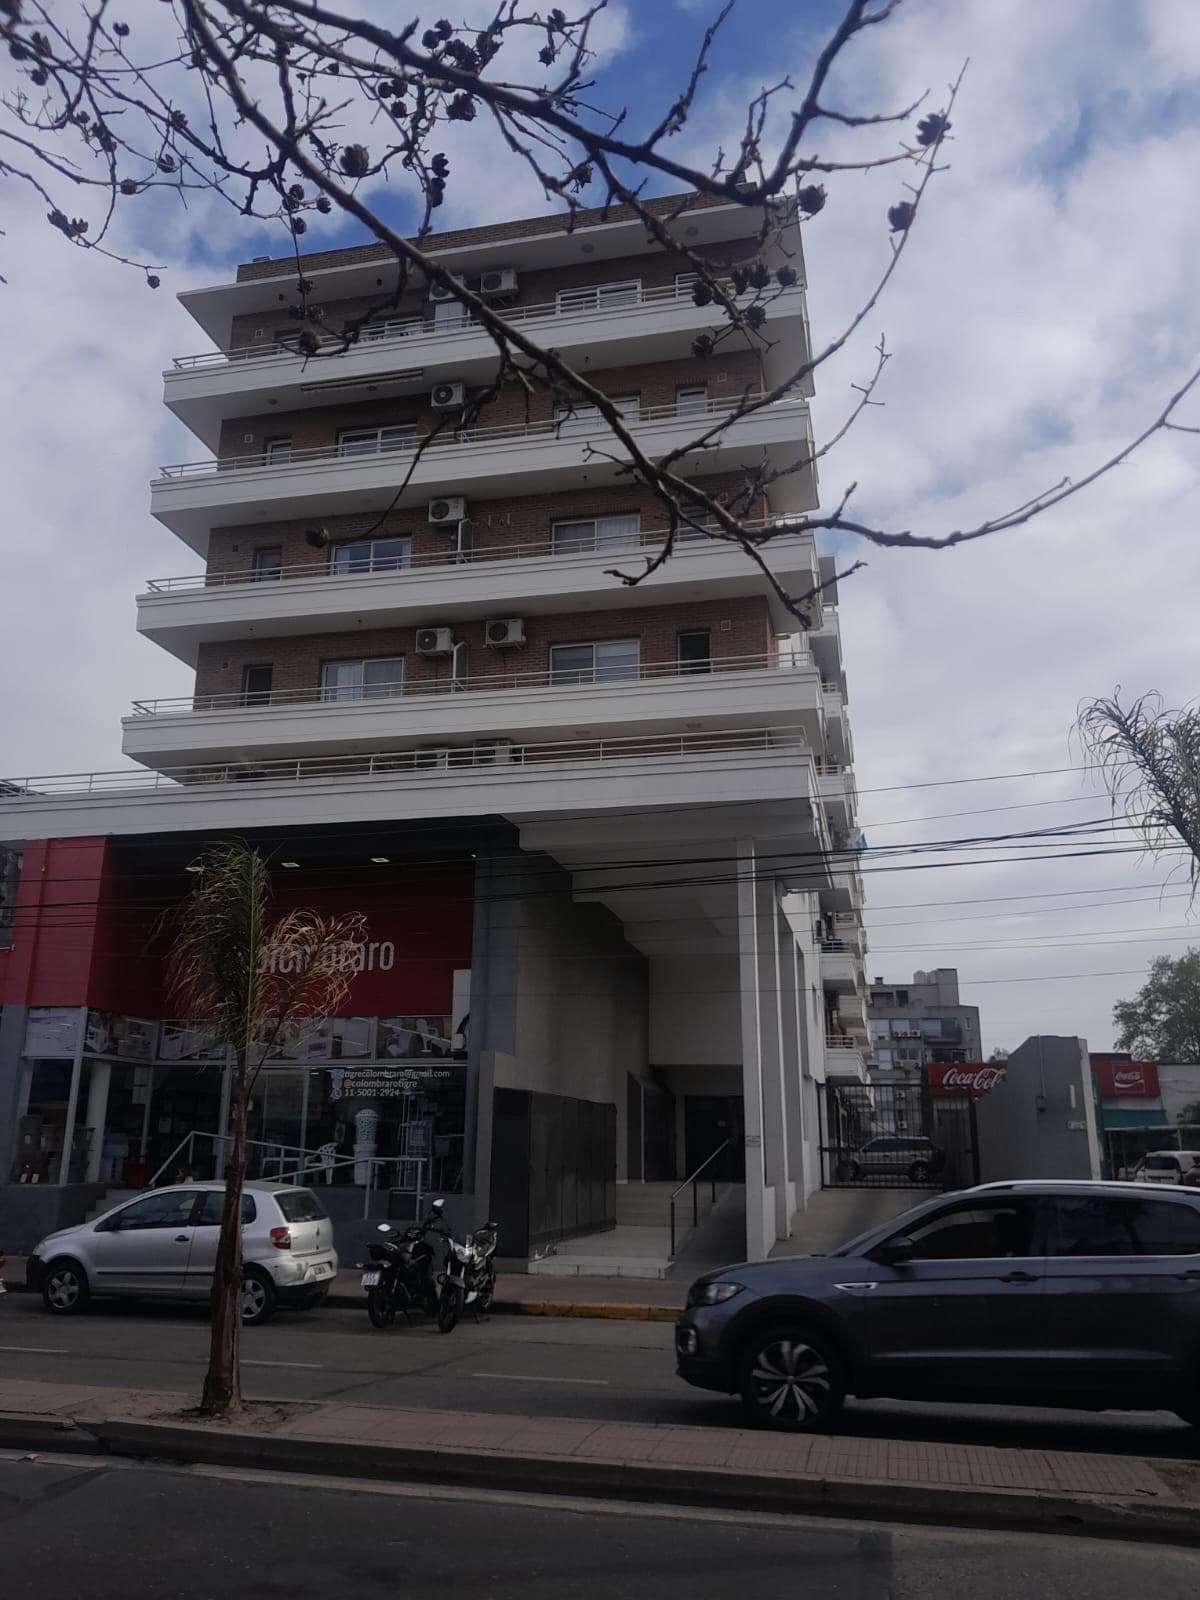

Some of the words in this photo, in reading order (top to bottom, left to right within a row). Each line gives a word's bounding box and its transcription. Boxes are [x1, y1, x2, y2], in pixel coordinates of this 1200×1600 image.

[942, 1068, 1007, 1089] Coca-Col
[343, 1079, 418, 1089] @colombrarotigre
[344, 1088, 400, 1097] 11-5001-2924
